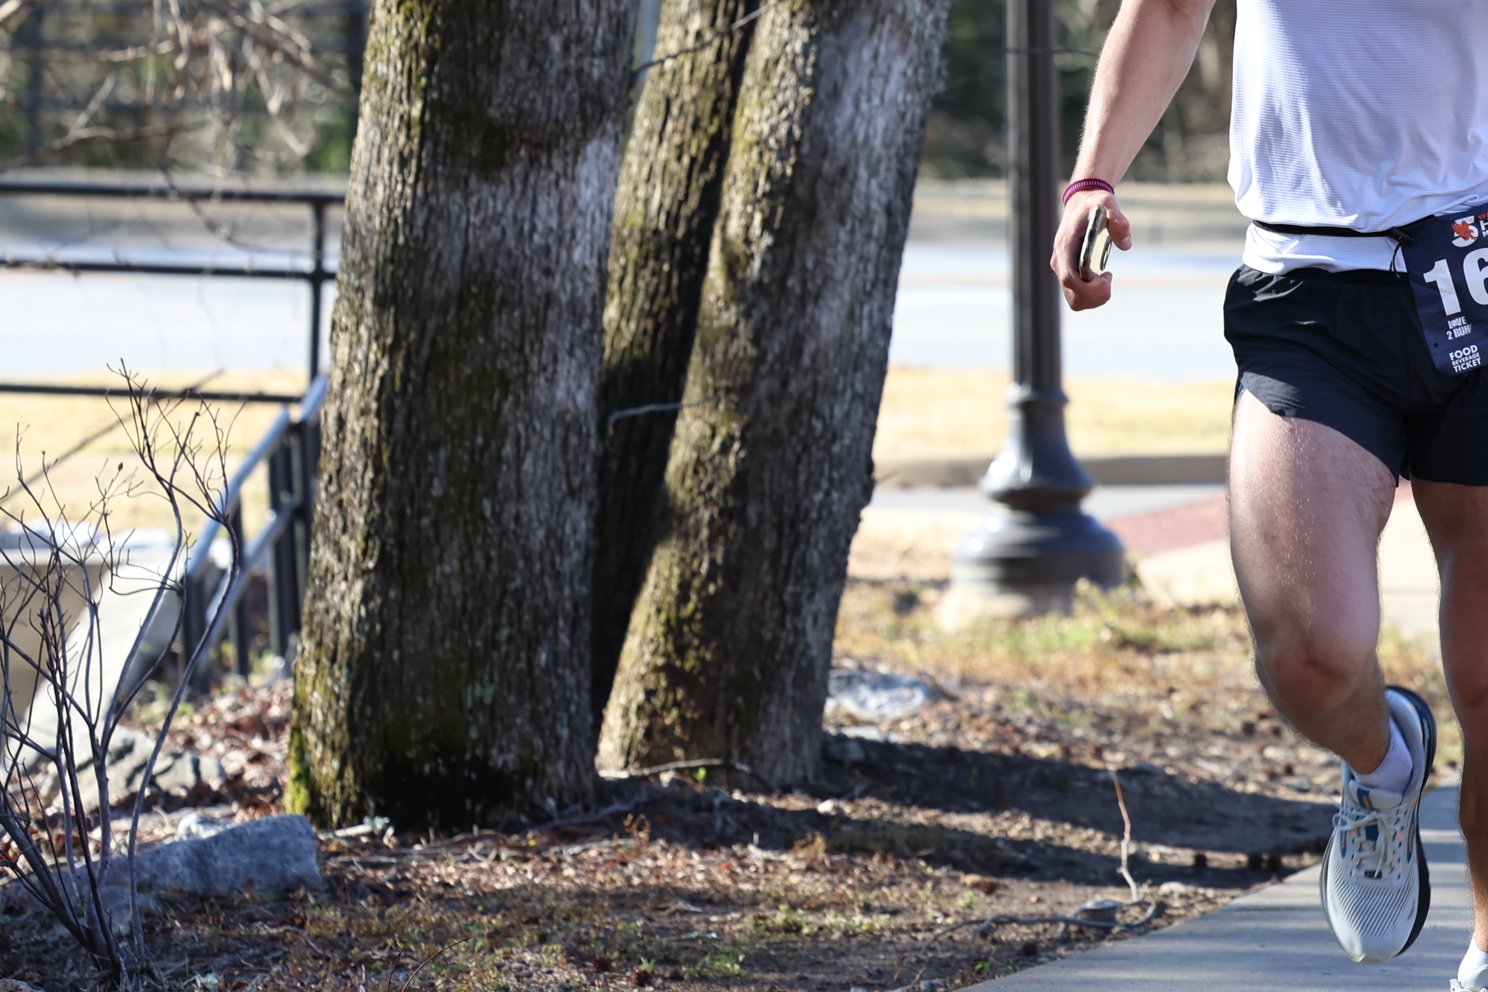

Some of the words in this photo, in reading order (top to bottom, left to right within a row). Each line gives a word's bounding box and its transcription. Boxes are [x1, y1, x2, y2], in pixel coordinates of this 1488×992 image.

[1446, 330, 1453, 340] 2
[1453, 324, 1471, 338] RUN
[1449, 345, 1478, 360] FOOD
[1453, 357, 1481, 372] TICKET
